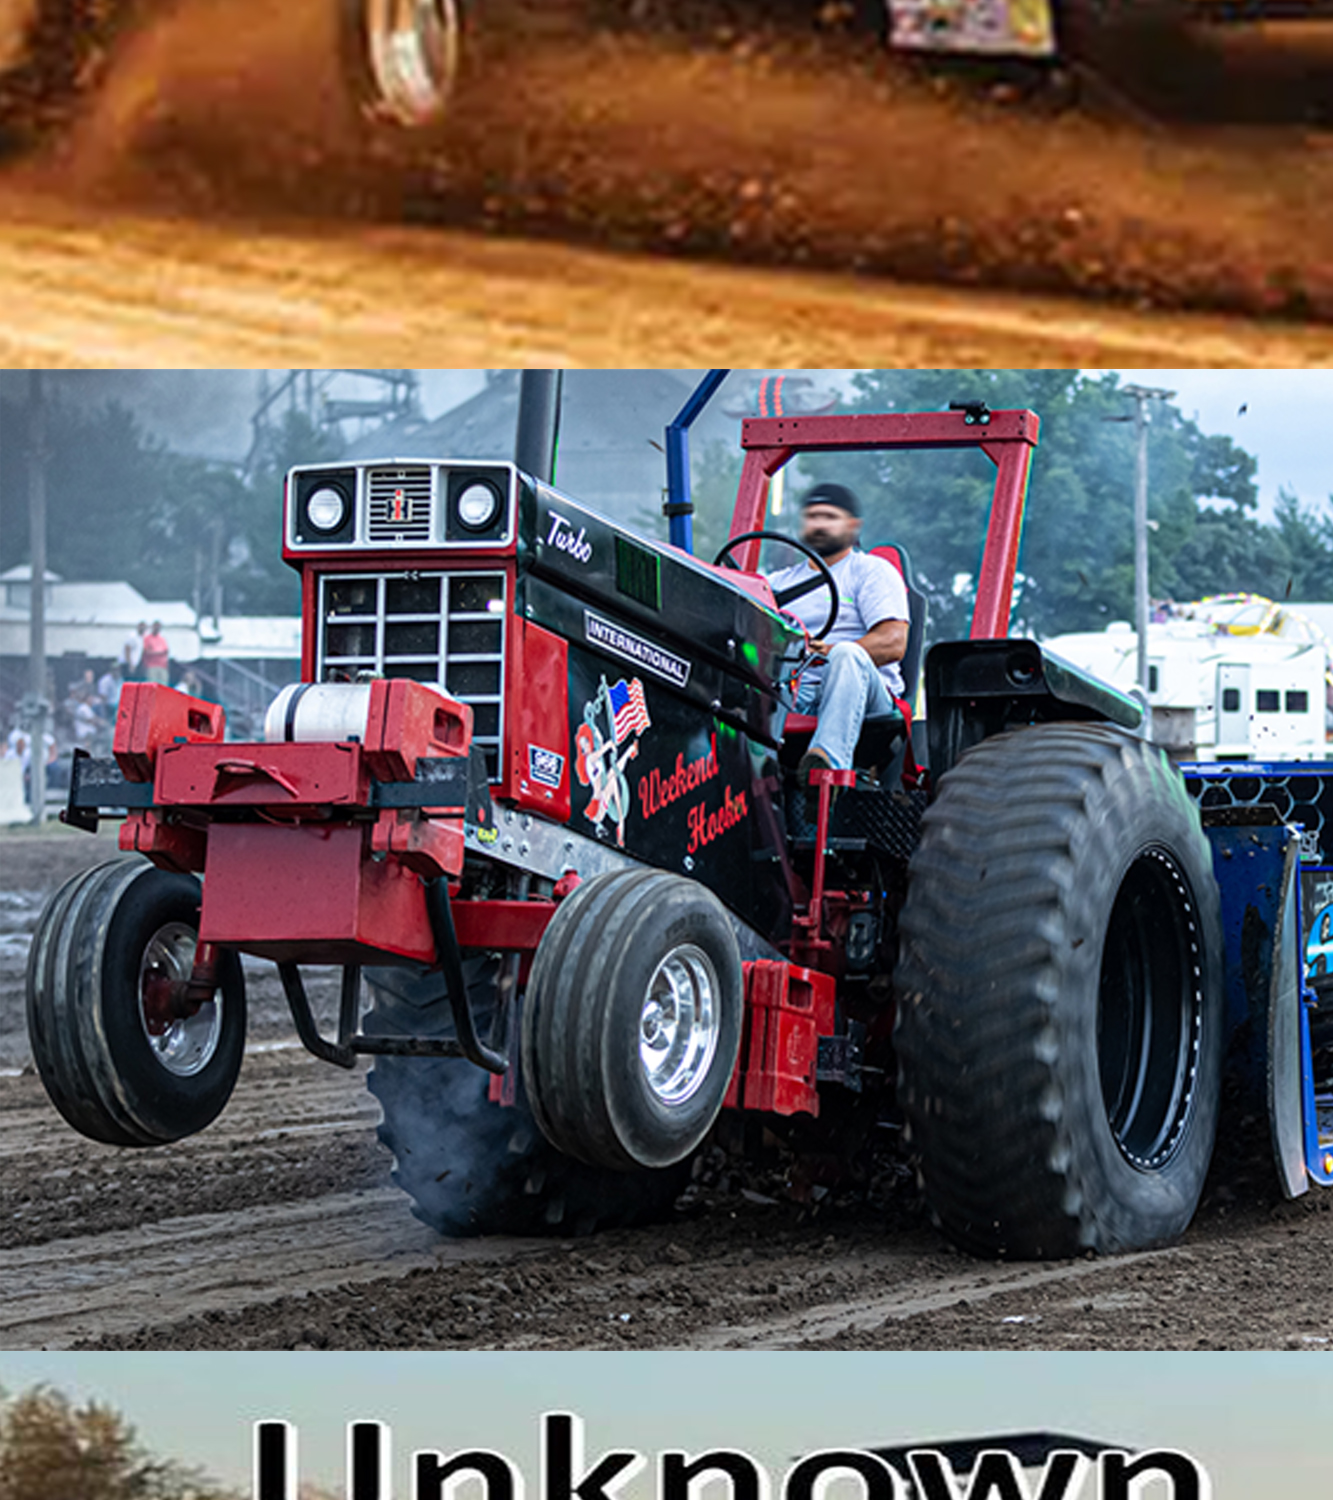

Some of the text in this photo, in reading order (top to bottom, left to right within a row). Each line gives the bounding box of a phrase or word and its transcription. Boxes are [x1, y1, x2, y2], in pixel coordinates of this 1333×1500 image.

[548, 510, 593, 564] Turbo
[588, 618, 687, 680] INTERNATIONAL
[637, 732, 721, 820] Weekend
